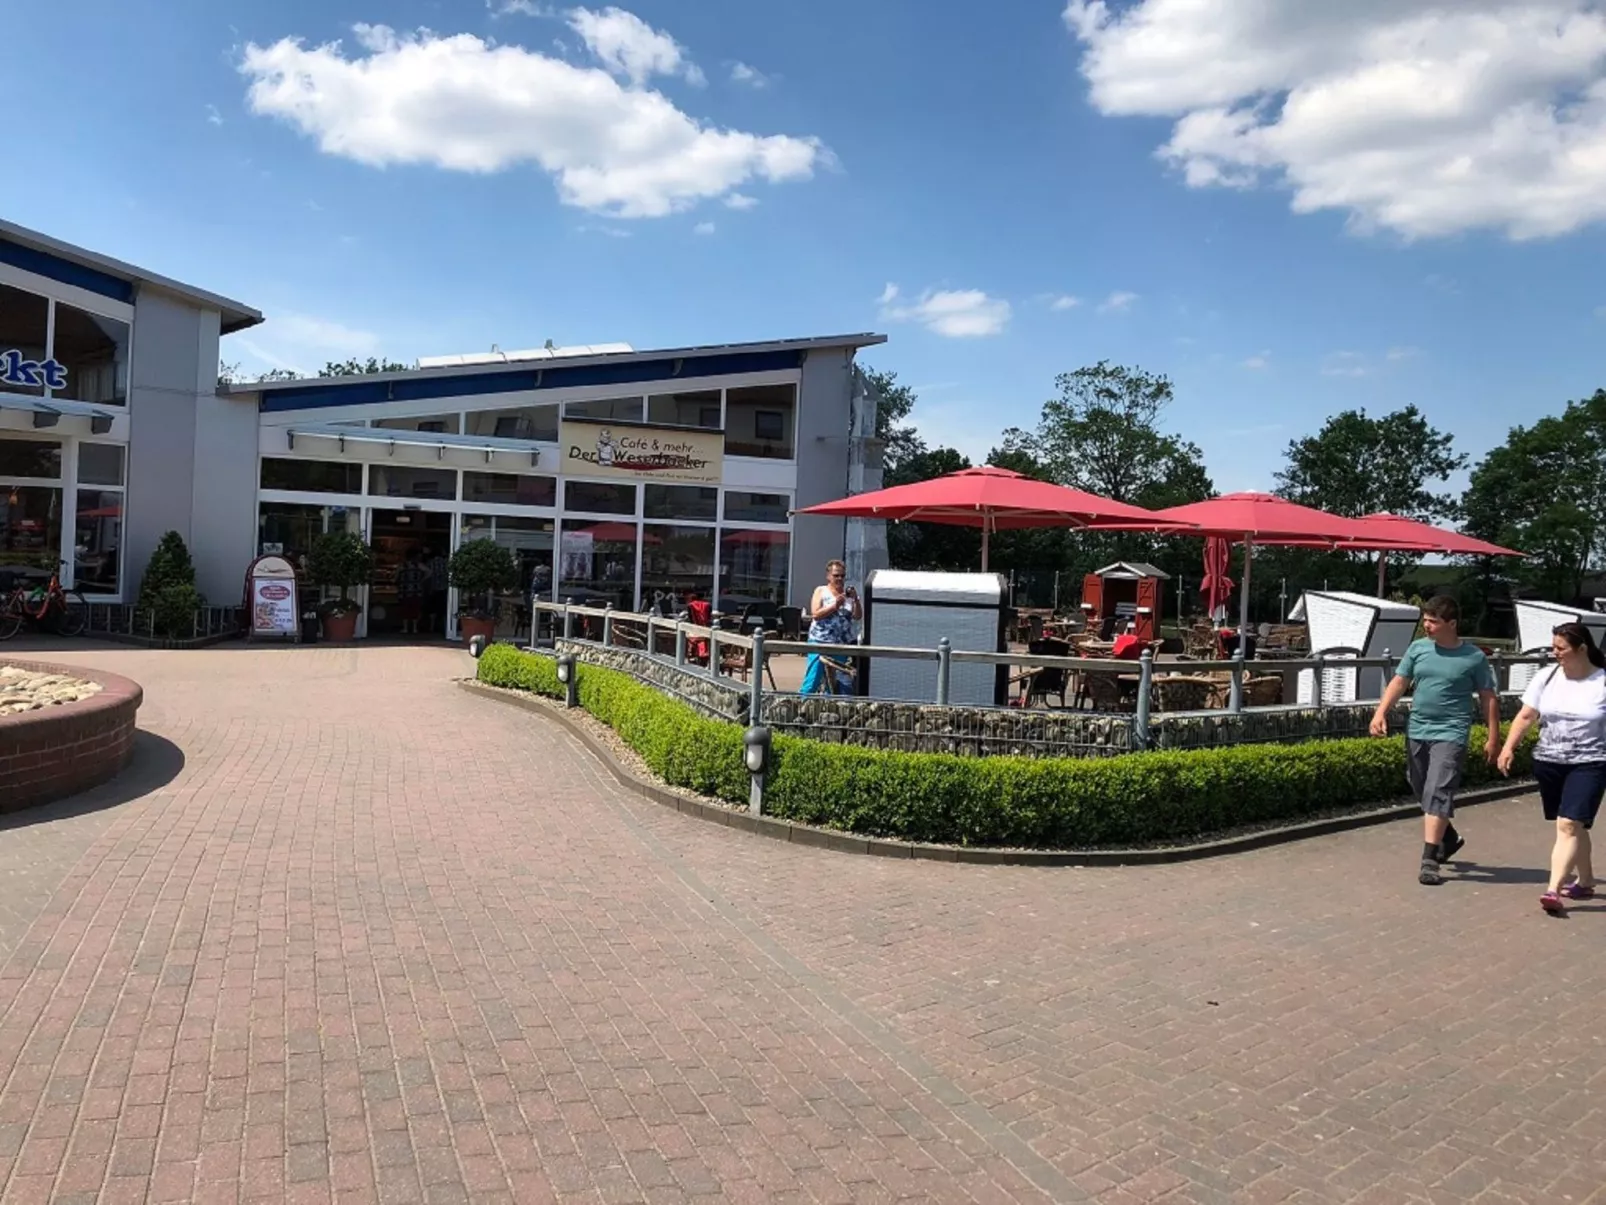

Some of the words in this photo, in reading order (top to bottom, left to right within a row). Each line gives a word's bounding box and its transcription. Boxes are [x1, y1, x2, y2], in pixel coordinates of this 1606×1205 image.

[620, 436, 648, 450] Café
[651, 438, 660, 451] &
[568, 446, 597, 461] Der
